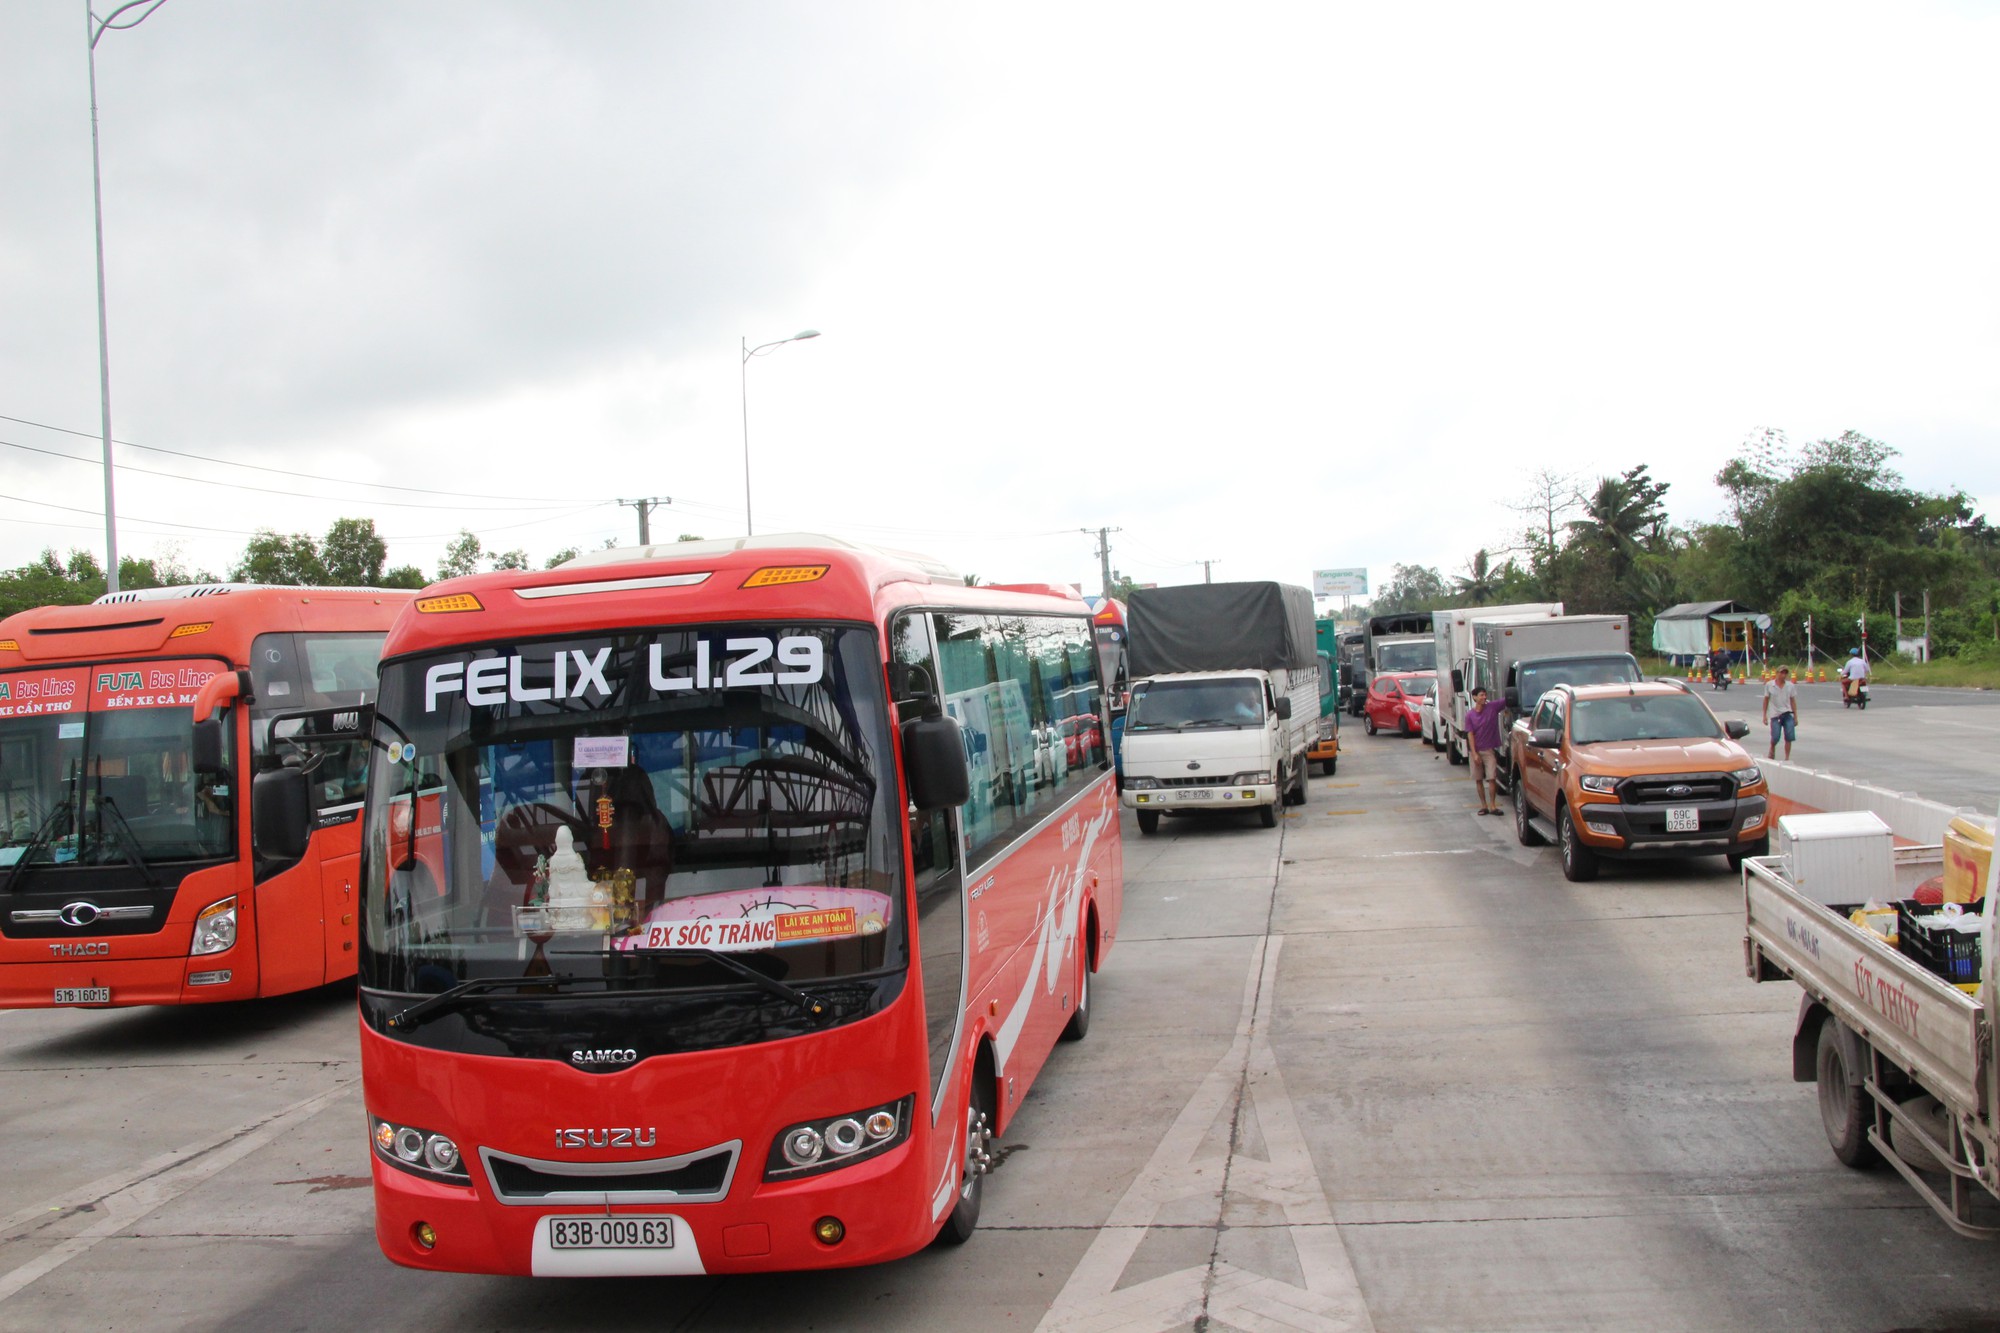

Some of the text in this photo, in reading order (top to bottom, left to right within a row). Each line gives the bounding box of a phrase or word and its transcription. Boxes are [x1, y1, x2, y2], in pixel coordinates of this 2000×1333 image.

[97, 671, 144, 692] FUTA
[149, 670, 175, 689] Bus
[425, 636, 824, 713] FELIX LI.29
[16, 680, 40, 699] Bus
[42, 677, 76, 697] Lines
[46, 700, 72, 712] THƠ
[107, 693, 134, 707] BẾN
[136, 695, 154, 705] XE
[1673, 810, 1690, 819] 69C
[1667, 820, 1697, 830] 025.65
[784, 916, 797, 927] LÁI
[800, 916, 809, 926] XE
[812, 915, 823, 924] AN
[648, 920, 774, 948] BX SÓC TRĂNG
[49, 943, 109, 956] THACO
[572, 1049, 636, 1064] SAMCO
[555, 1127, 656, 1148] ISUZU
[555, 1222, 668, 1245] 83B-009.63
